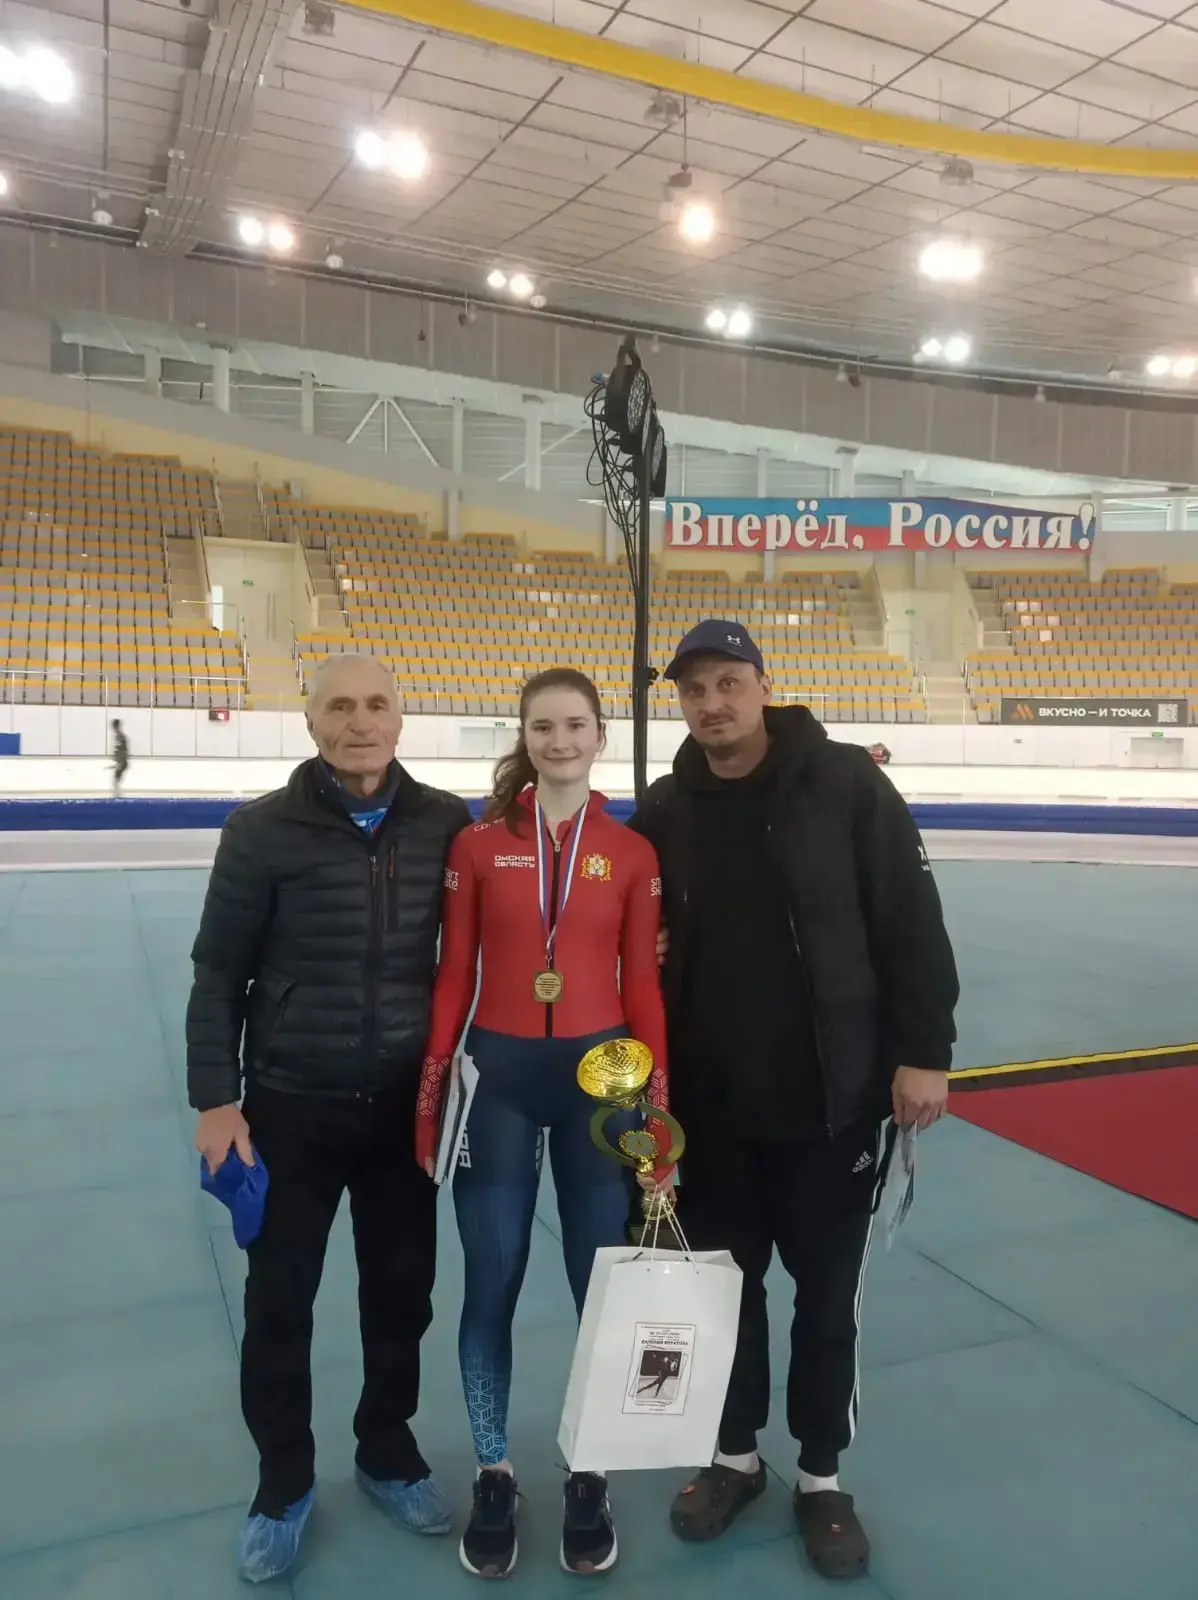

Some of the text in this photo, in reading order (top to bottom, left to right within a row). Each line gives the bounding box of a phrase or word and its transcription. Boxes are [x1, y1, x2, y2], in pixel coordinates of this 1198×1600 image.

[670, 500, 1095, 551] Вперёд, Россия!
[1038, 707, 1086, 717] ВКУСНО
[1099, 707, 1108, 717] И
[1111, 708, 1152, 718] ТОЧКА
